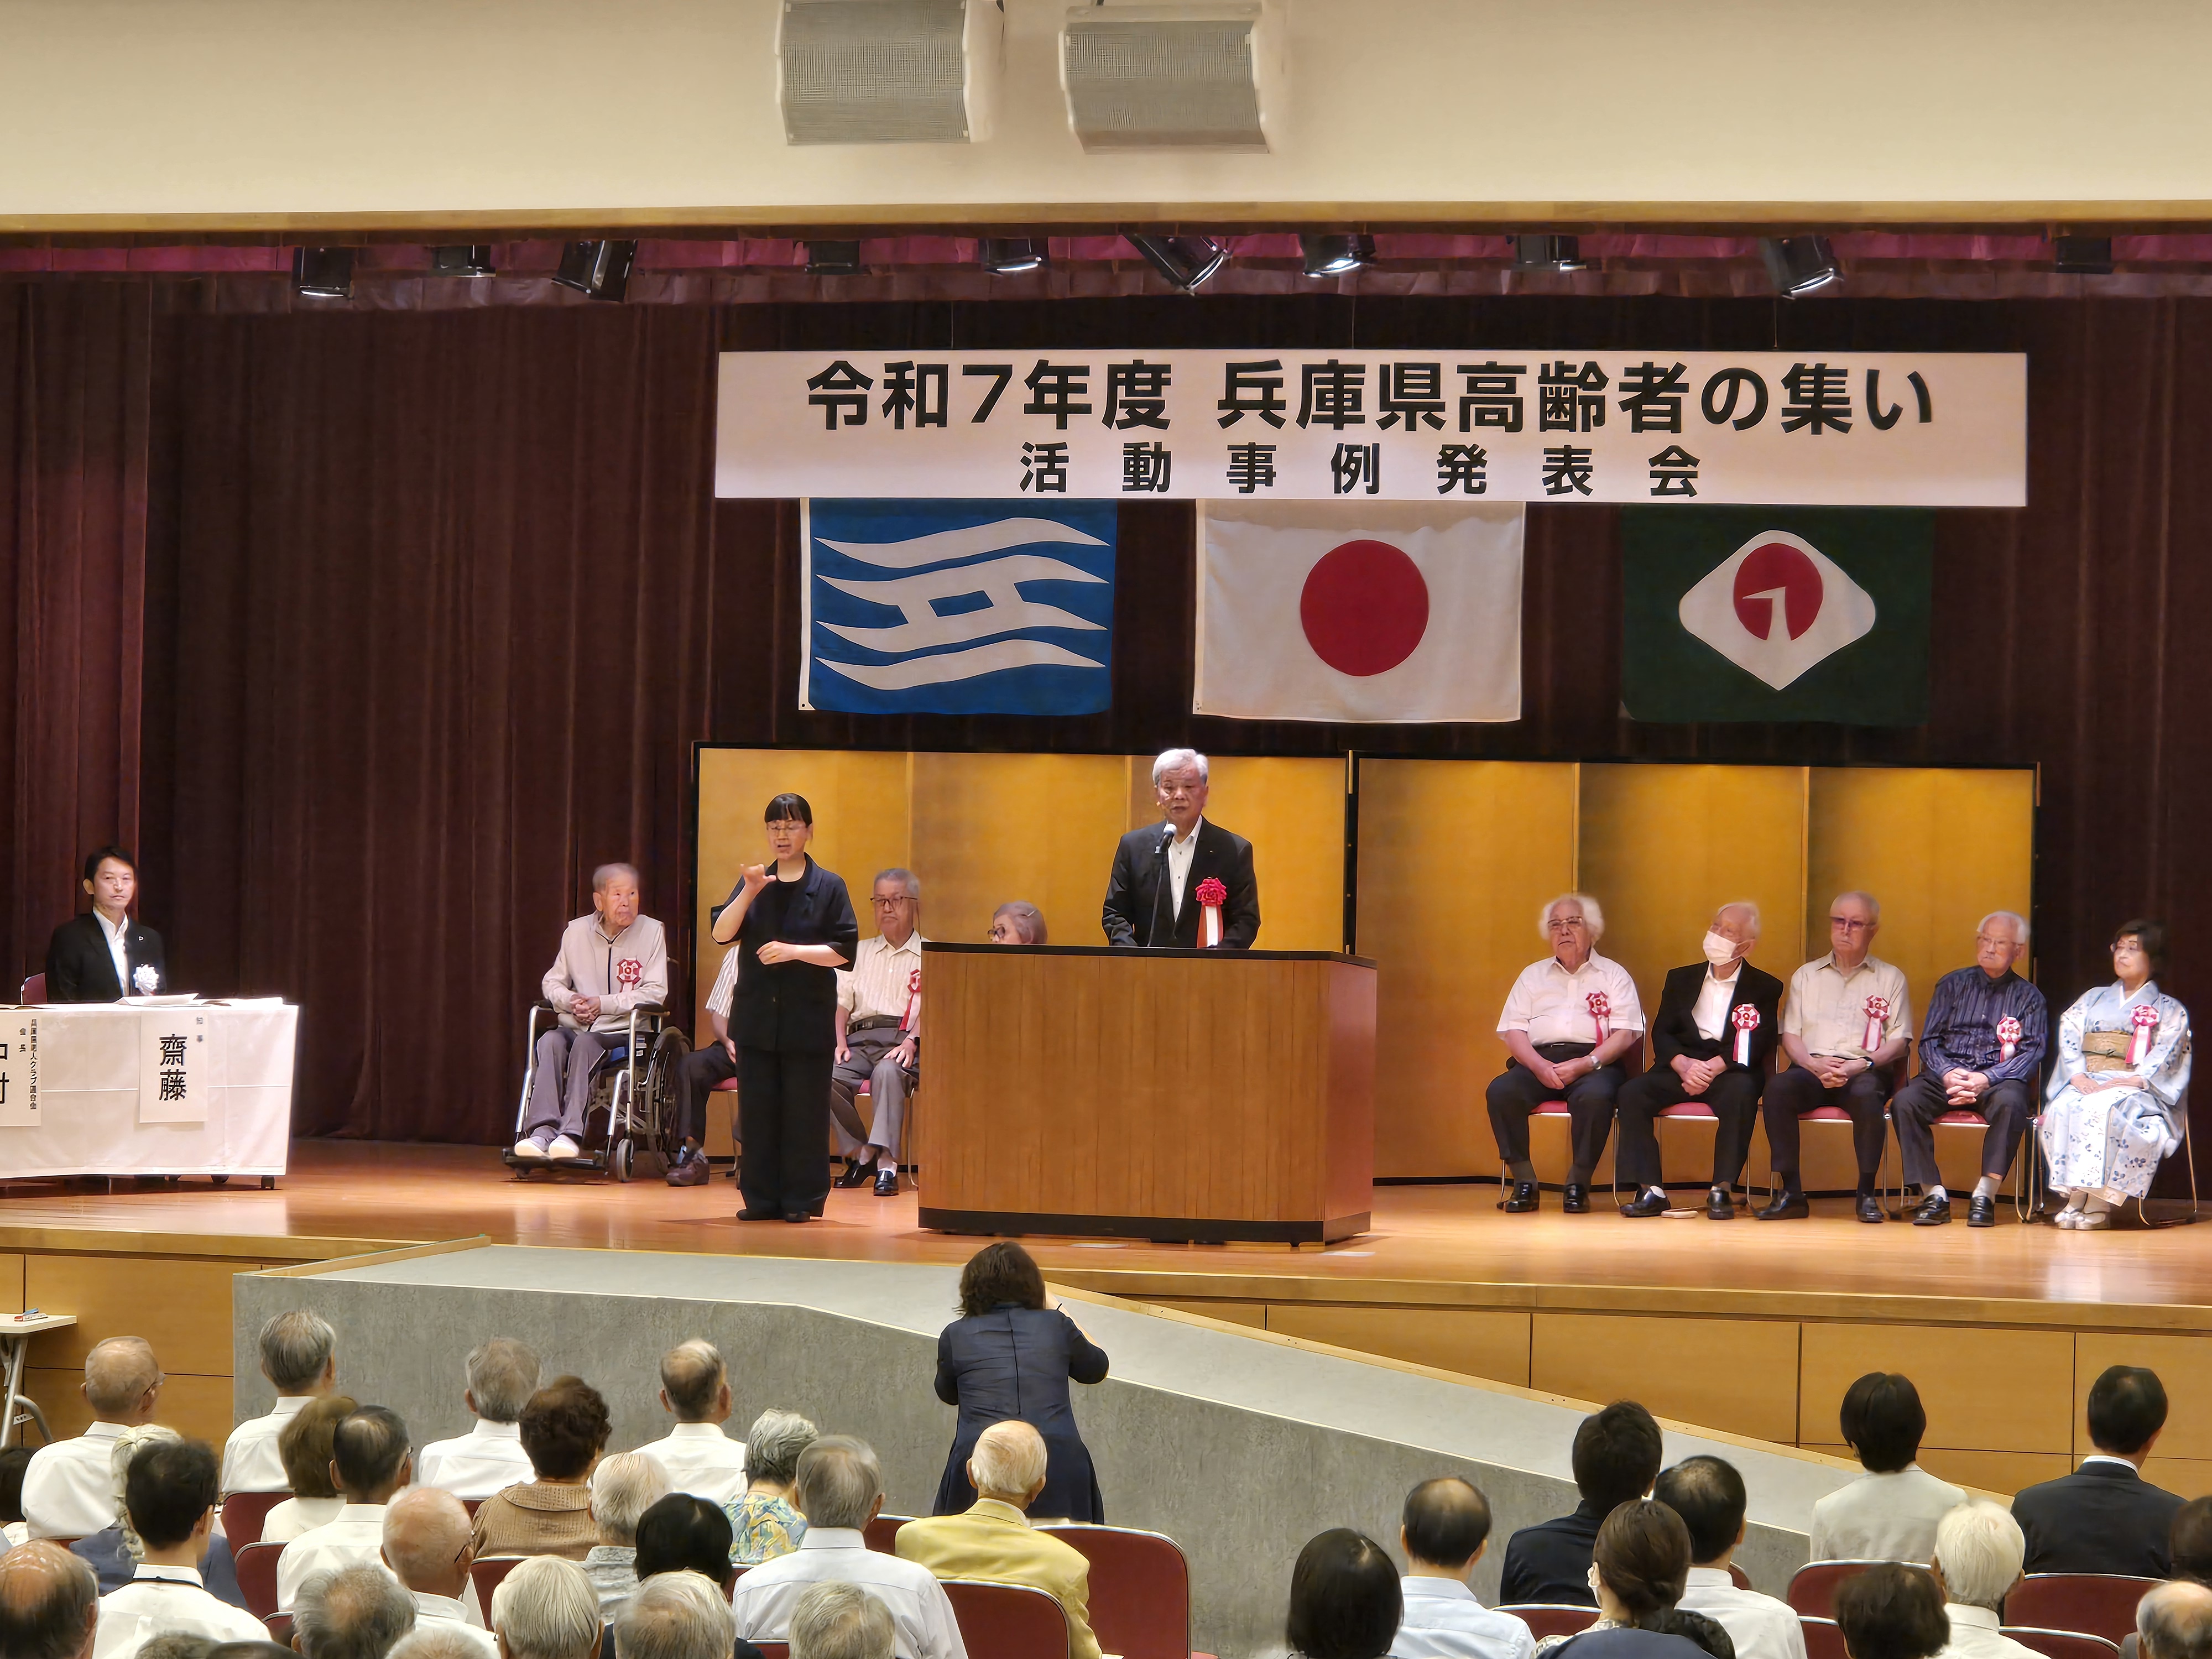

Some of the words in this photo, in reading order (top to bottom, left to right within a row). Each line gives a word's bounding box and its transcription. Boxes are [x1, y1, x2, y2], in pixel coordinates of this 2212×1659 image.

[806, 359, 1171, 430] 令和7年度
[1217, 359, 1932, 435] 兵庫県高齢者の集い
[1020, 442, 1700, 497] 活動事例発表会
[159, 1034, 187, 1101] 齋藤
